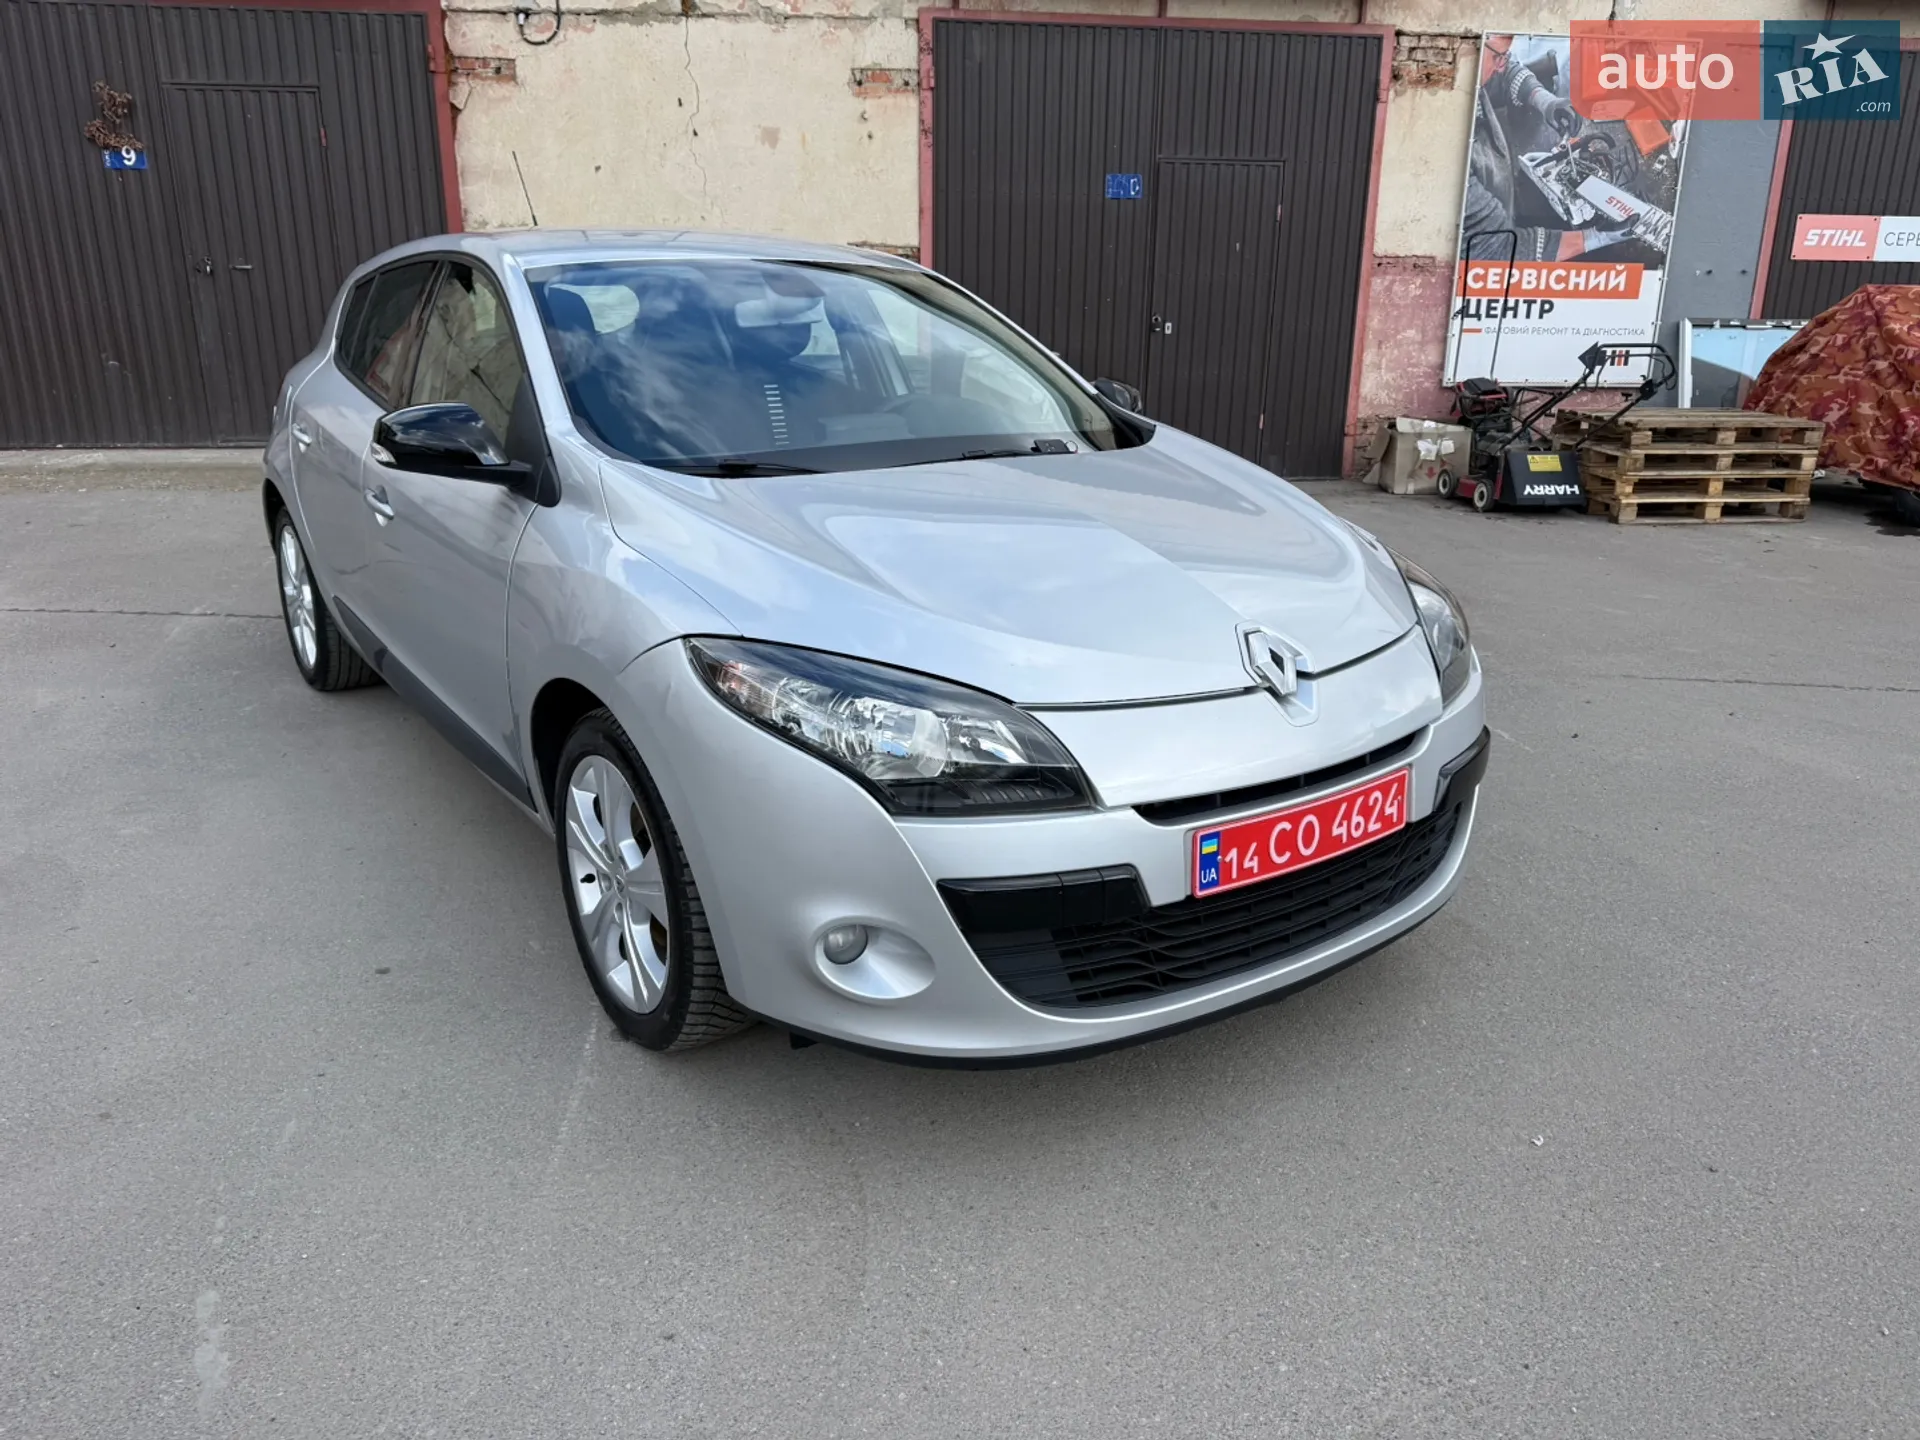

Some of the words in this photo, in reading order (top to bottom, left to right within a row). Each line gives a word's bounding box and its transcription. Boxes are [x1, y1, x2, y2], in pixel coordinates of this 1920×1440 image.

[121, 145, 136, 166] 9
[1803, 229, 1867, 247] STIHL
[1466, 264, 1628, 292] СЕРВІСНИЙ
[1464, 299, 1555, 321] ЦЕНТР
[1531, 326, 1568, 336] РЕМОНТ
[1571, 327, 1581, 336] ТА
[1523, 484, 1580, 496] HARRY
[1224, 842, 1259, 879] 14
[1269, 814, 1320, 864] CO
[1332, 783, 1402, 844] 4624
[1201, 867, 1218, 884] UA
